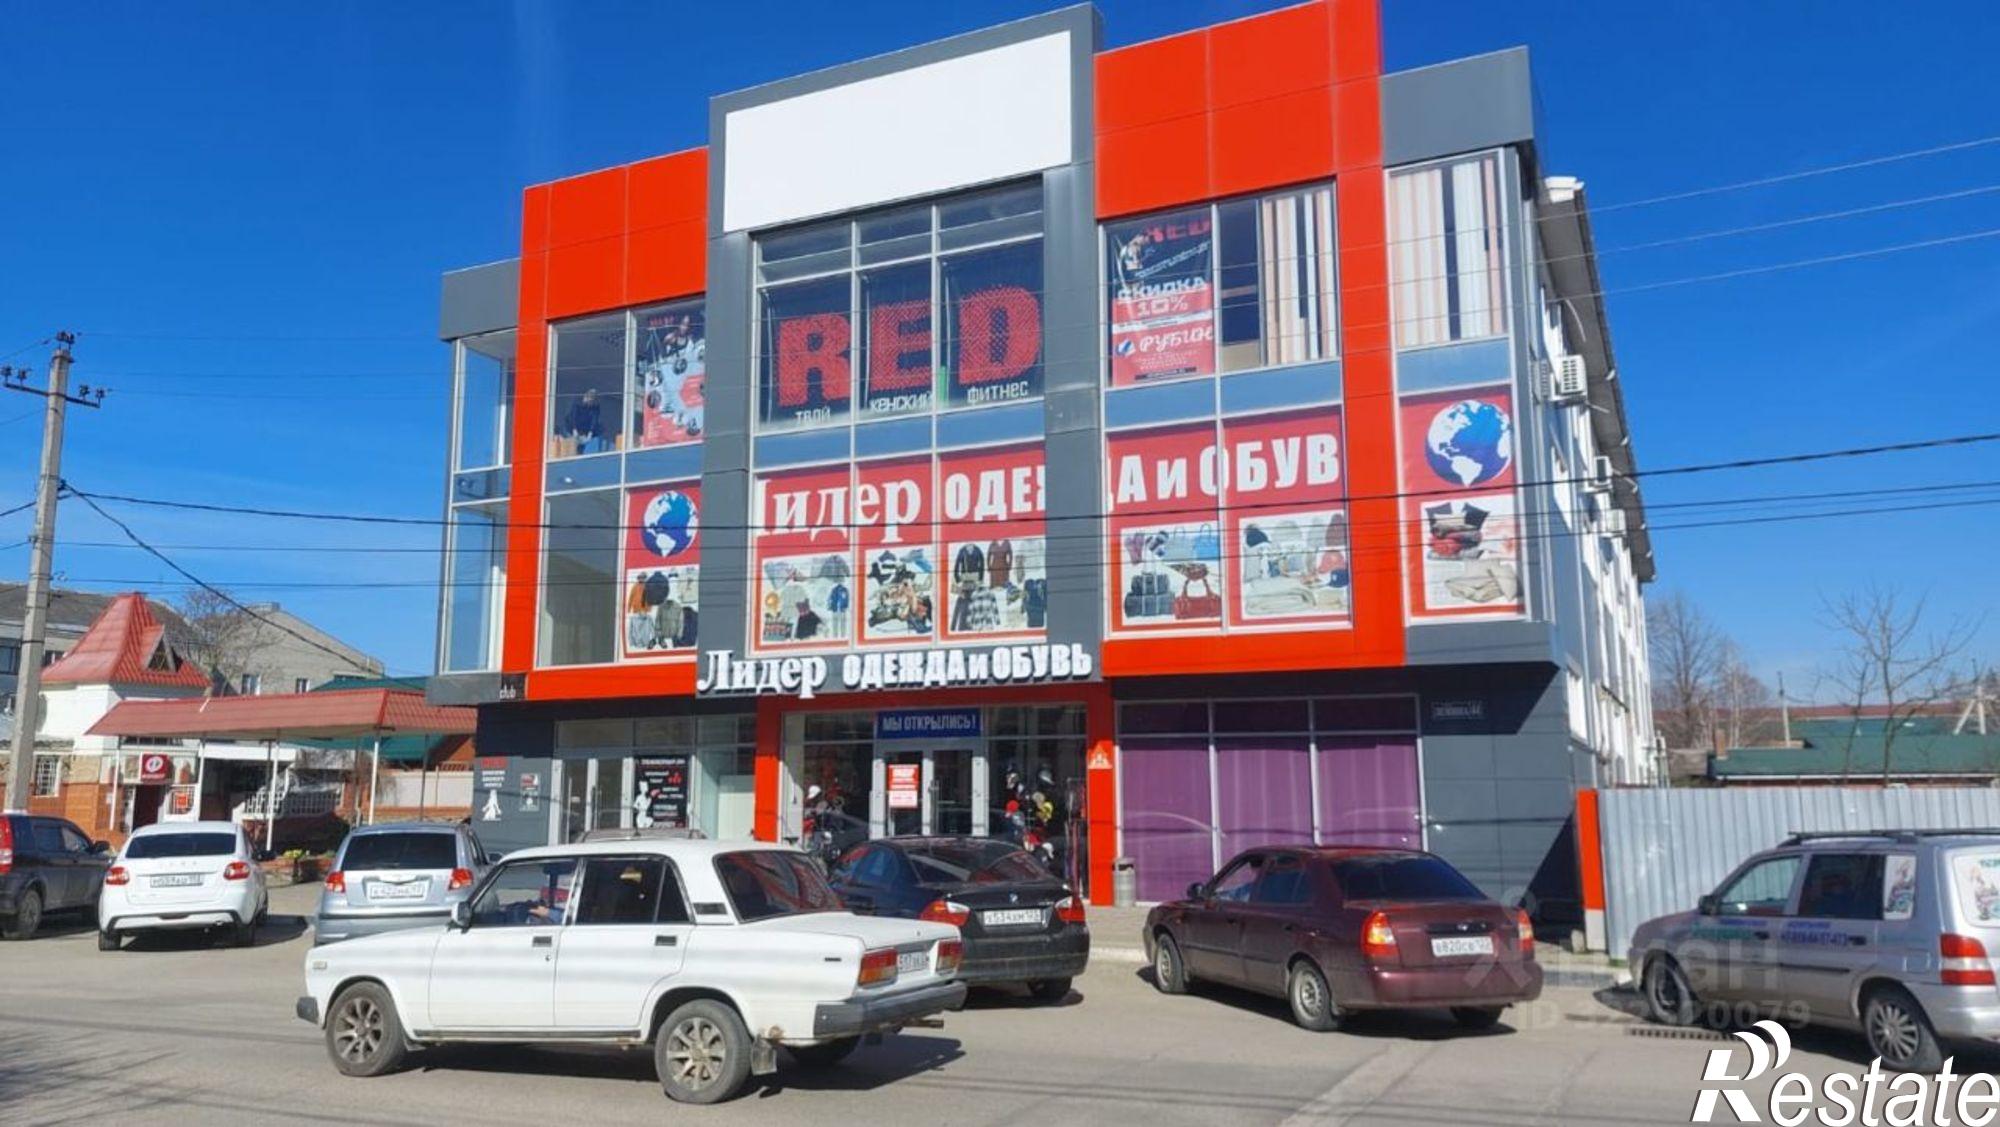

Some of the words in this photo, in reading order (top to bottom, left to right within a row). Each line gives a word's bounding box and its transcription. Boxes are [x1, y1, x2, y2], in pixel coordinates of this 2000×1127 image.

[1117, 276, 1207, 301] СКИДКА
[1137, 295, 1189, 317] 10%
[776, 284, 1041, 408] RED
[697, 649, 828, 699] Лидер
[882, 716, 903, 732] МЫ
